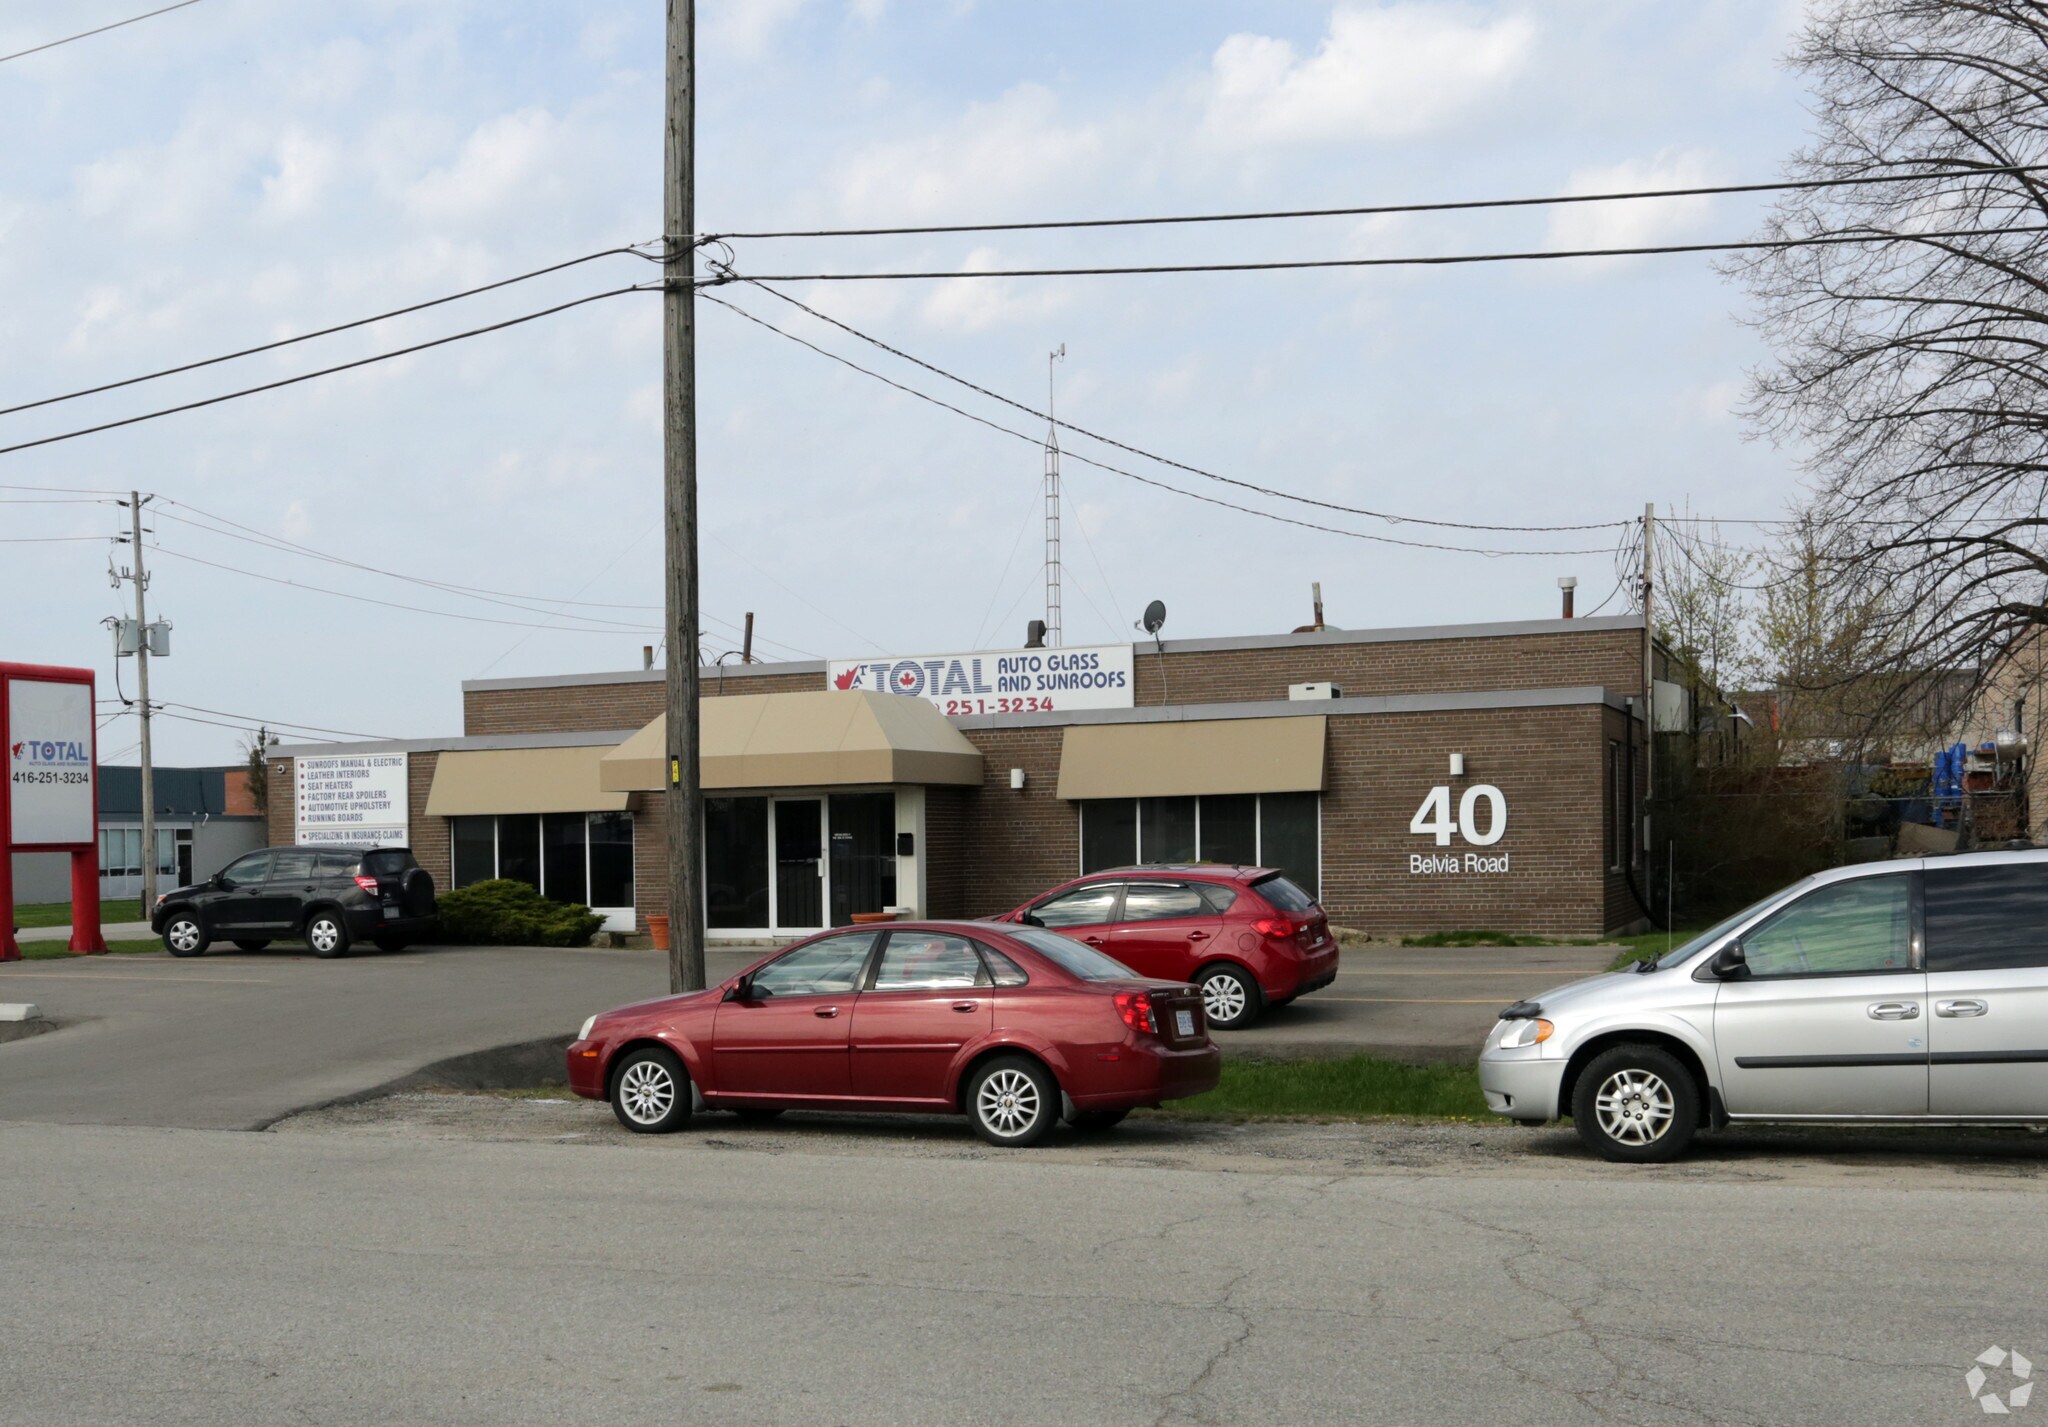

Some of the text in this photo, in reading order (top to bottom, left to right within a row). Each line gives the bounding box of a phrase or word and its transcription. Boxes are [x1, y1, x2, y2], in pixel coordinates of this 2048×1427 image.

[998, 653, 1099, 674] AUTO GLASS
[869, 658, 993, 697] TOTAL
[998, 671, 1126, 692] AND SUNROOFS
[946, 696, 1054, 716] 251-3234
[28, 740, 89, 761] TOTAL
[307, 758, 403, 769] SUNROOFS MANUAL & ELECTRIC
[12, 771, 89, 784] 416-251-3234
[307, 769, 370, 780] LEATHER INTERIORS
[307, 781, 353, 791] SEAT HEATERS
[307, 790, 387, 801] FACTORY REAR SPOILERS
[308, 801, 391, 812] AUTOMOTIVE UPHOLSTERY
[307, 813, 363, 822] RUNNING BOARDS
[1409, 783, 1508, 847] 40
[308, 830, 403, 841] SPECIALIZING IN INSURANCE CLAIMS
[1410, 852, 1509, 874] Belvia Road
